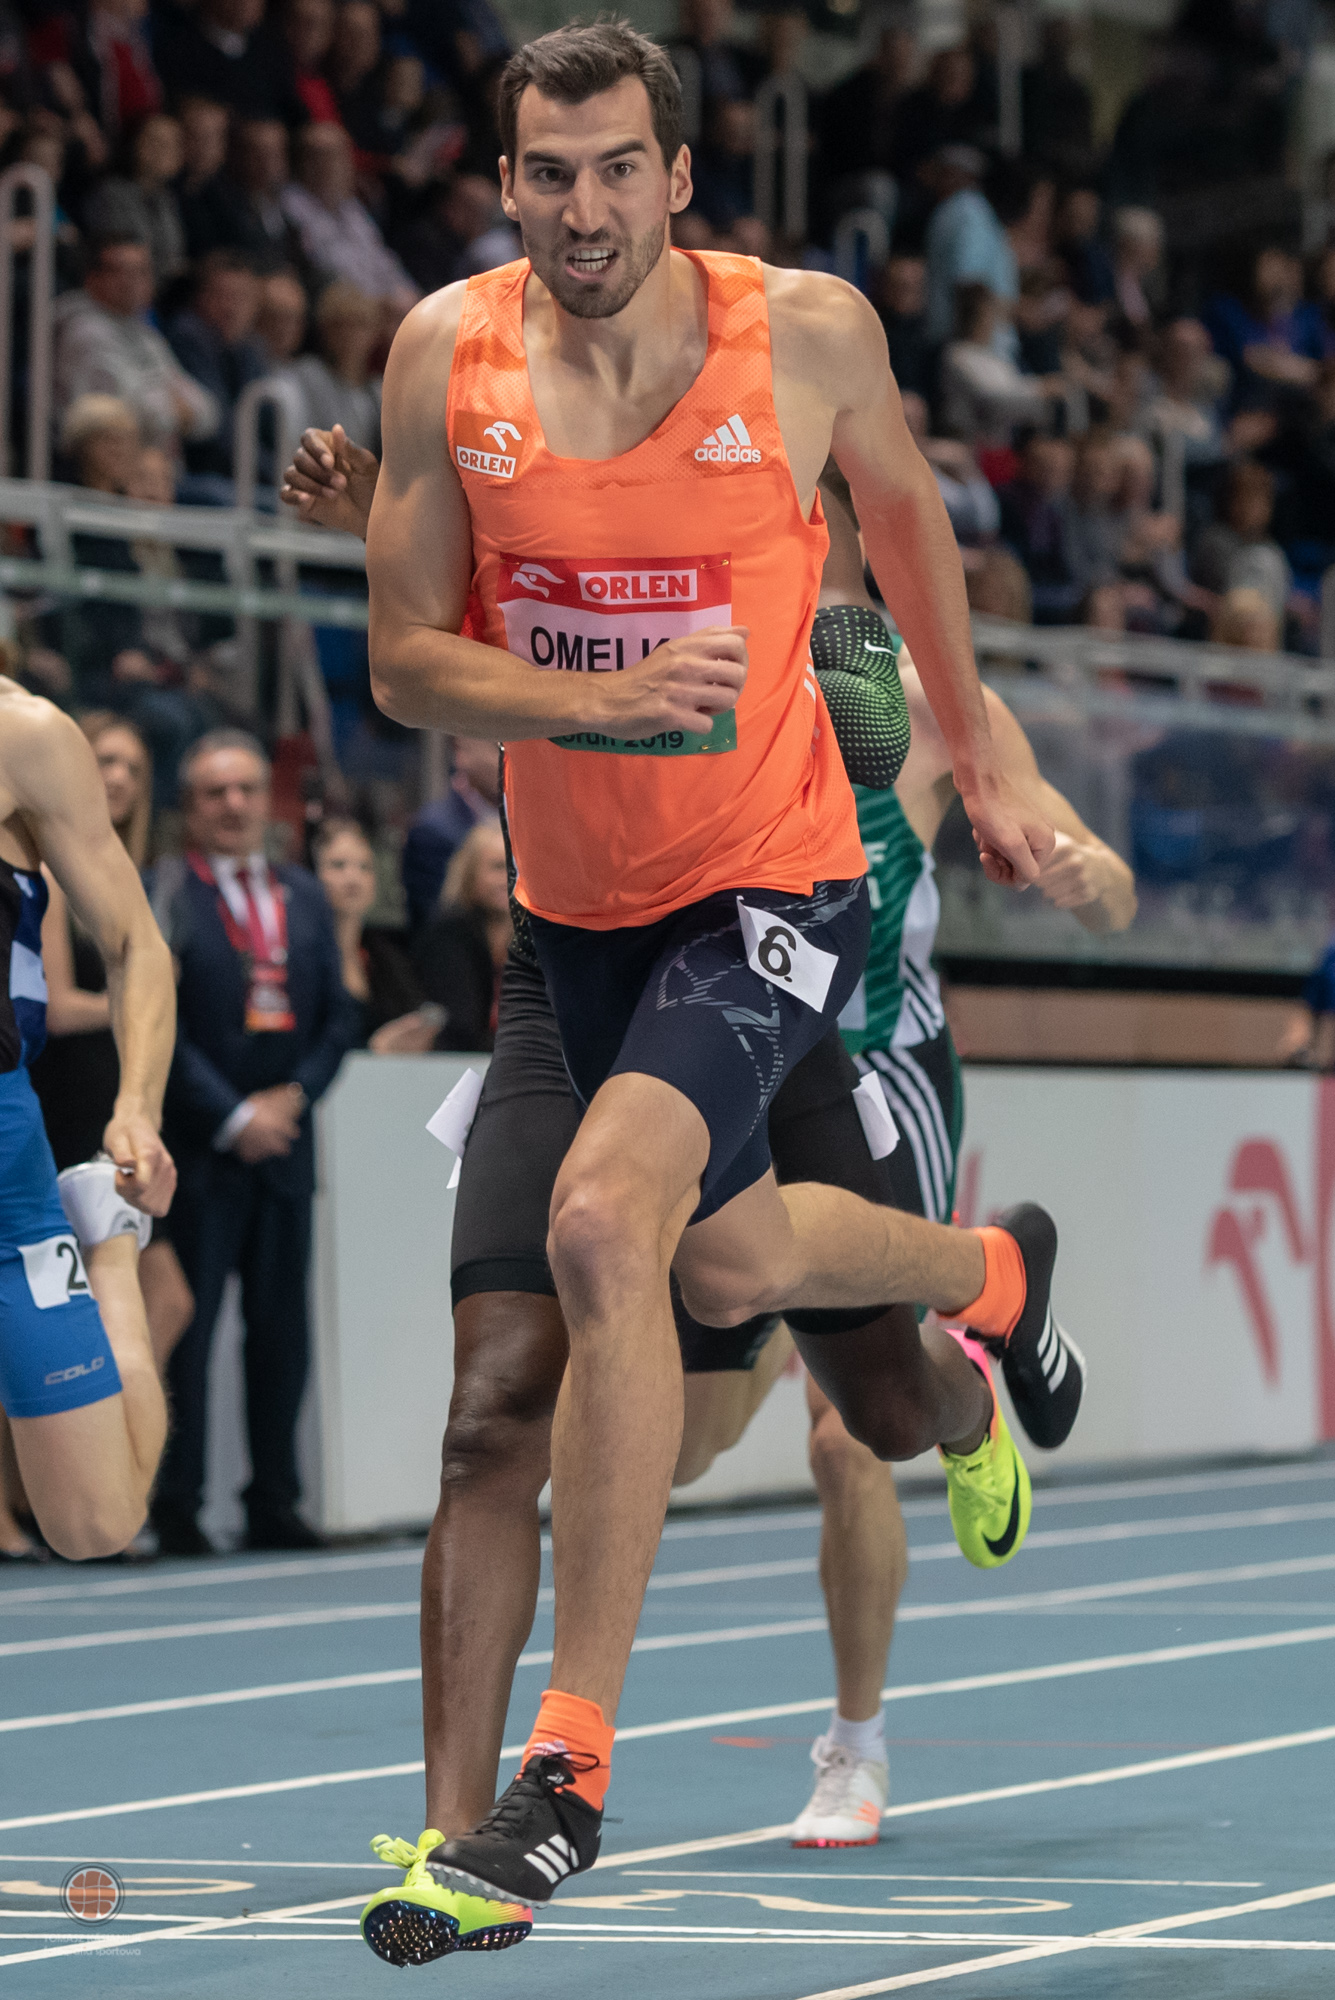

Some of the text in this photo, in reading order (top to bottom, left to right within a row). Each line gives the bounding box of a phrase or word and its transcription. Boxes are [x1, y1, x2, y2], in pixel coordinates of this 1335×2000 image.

[459, 450, 513, 475] ORLEN
[694, 444, 762, 463] adidas
[584, 574, 690, 600] ORLEN
[530, 625, 671, 672] OMELK
[56, 1241, 88, 1290] 2
[44, 1355, 105, 1386] COLO
